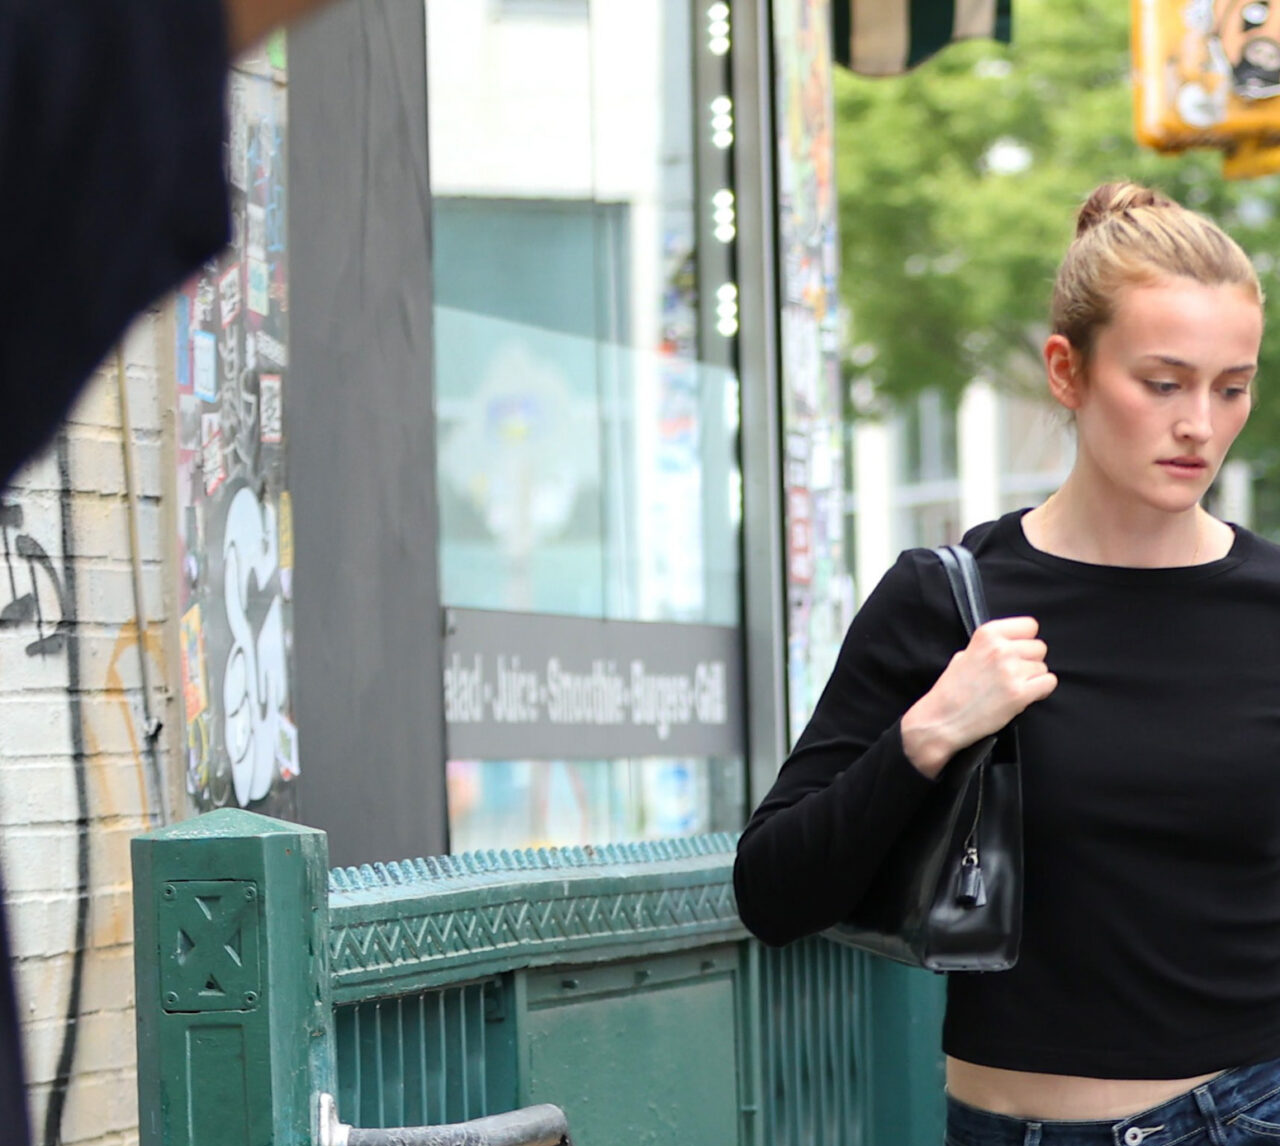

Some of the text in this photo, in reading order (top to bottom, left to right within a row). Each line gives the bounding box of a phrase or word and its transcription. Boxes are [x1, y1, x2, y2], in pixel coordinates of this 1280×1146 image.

[492, 654, 539, 723] Juice
[547, 657, 624, 725] Smoothie
[630, 659, 690, 740] Burgers
